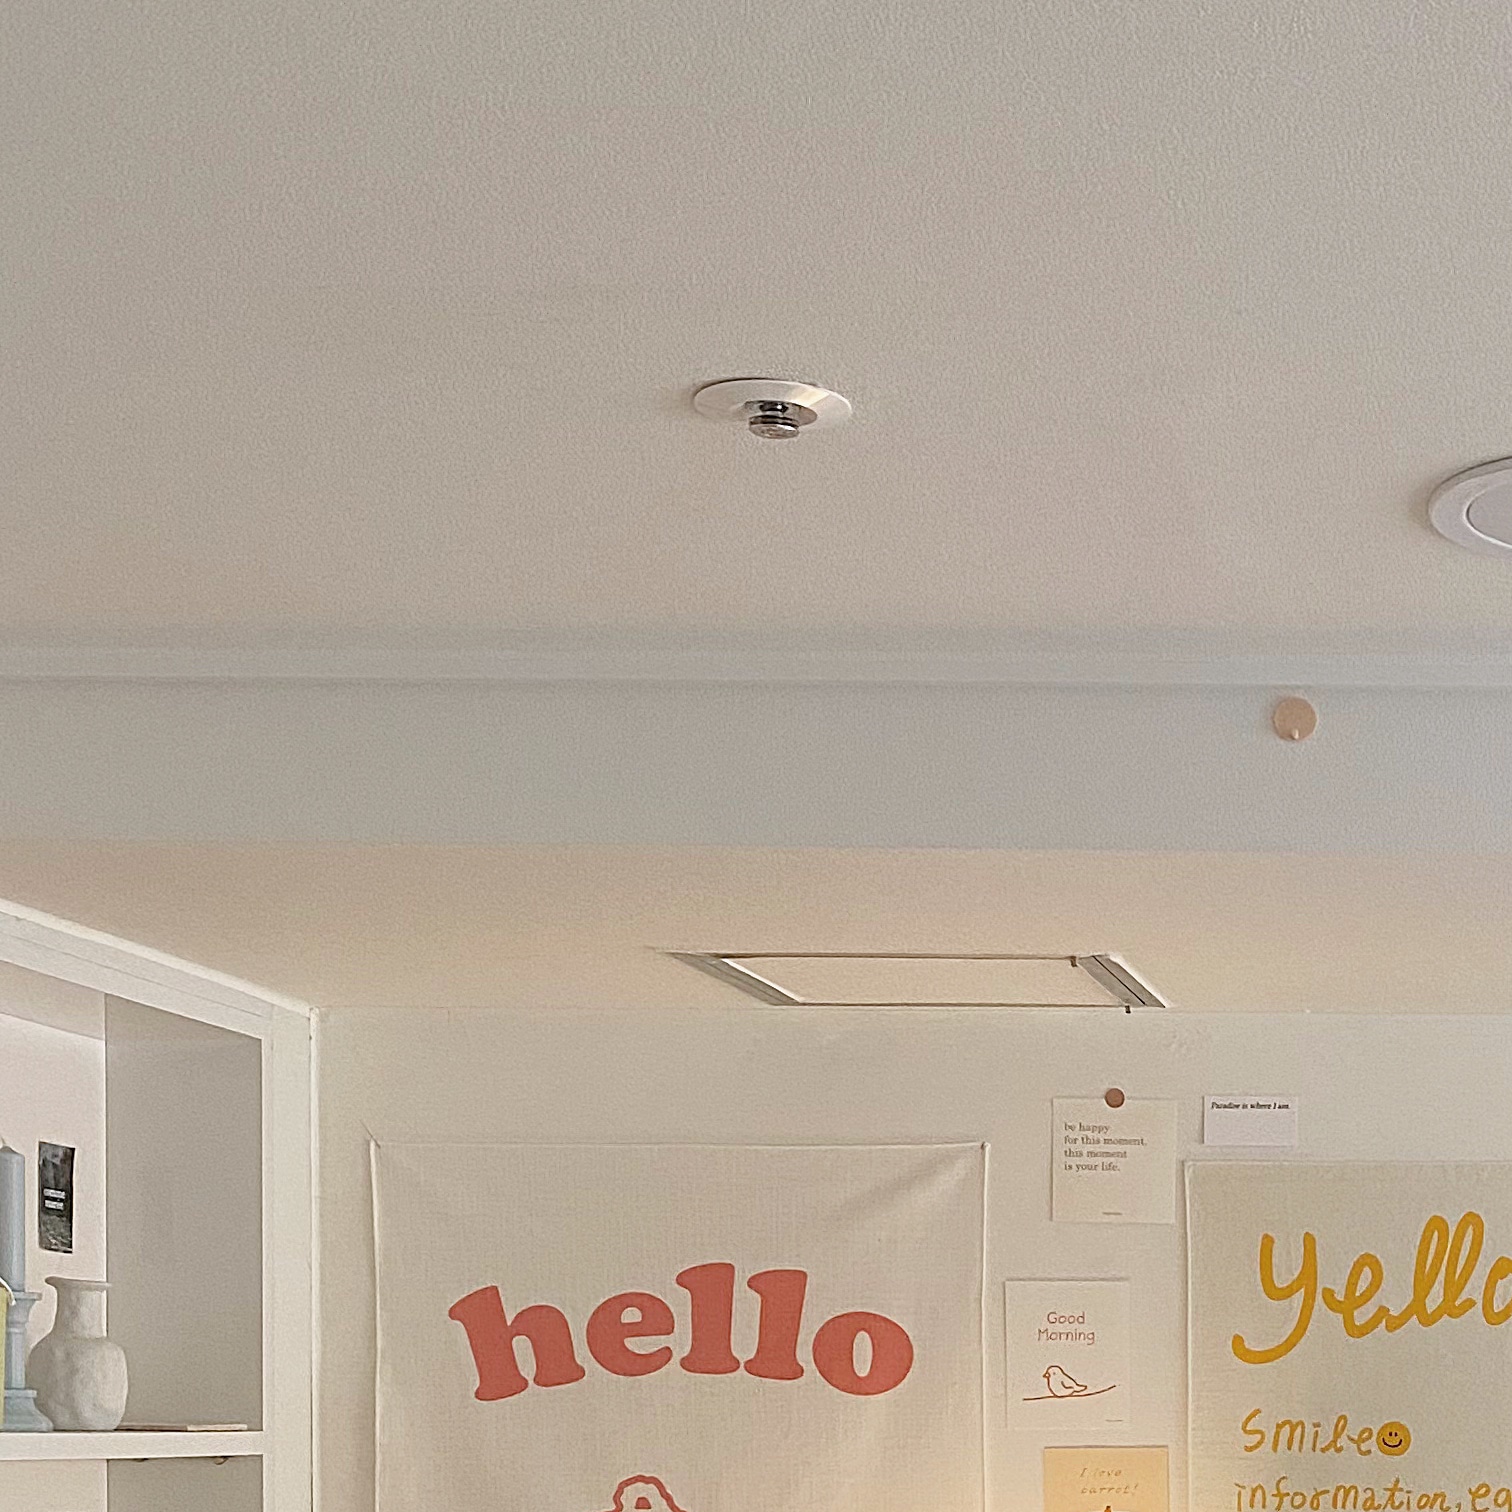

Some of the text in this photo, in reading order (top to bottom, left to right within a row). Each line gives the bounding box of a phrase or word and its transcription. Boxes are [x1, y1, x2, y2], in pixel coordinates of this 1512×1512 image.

[1064, 1122, 1111, 1134] be happy
[1064, 1135, 1079, 1145] for
[1081, 1135, 1101, 1145] this
[1064, 1148, 1127, 1158] this moment
[1064, 1161, 1074, 1171] is
[1076, 1163, 1098, 1173] your
[1046, 1311, 1086, 1325] Good
[448, 1261, 915, 1402] hello
[1037, 1327, 1096, 1346] Morning
[1240, 1407, 1378, 1457] Smile
